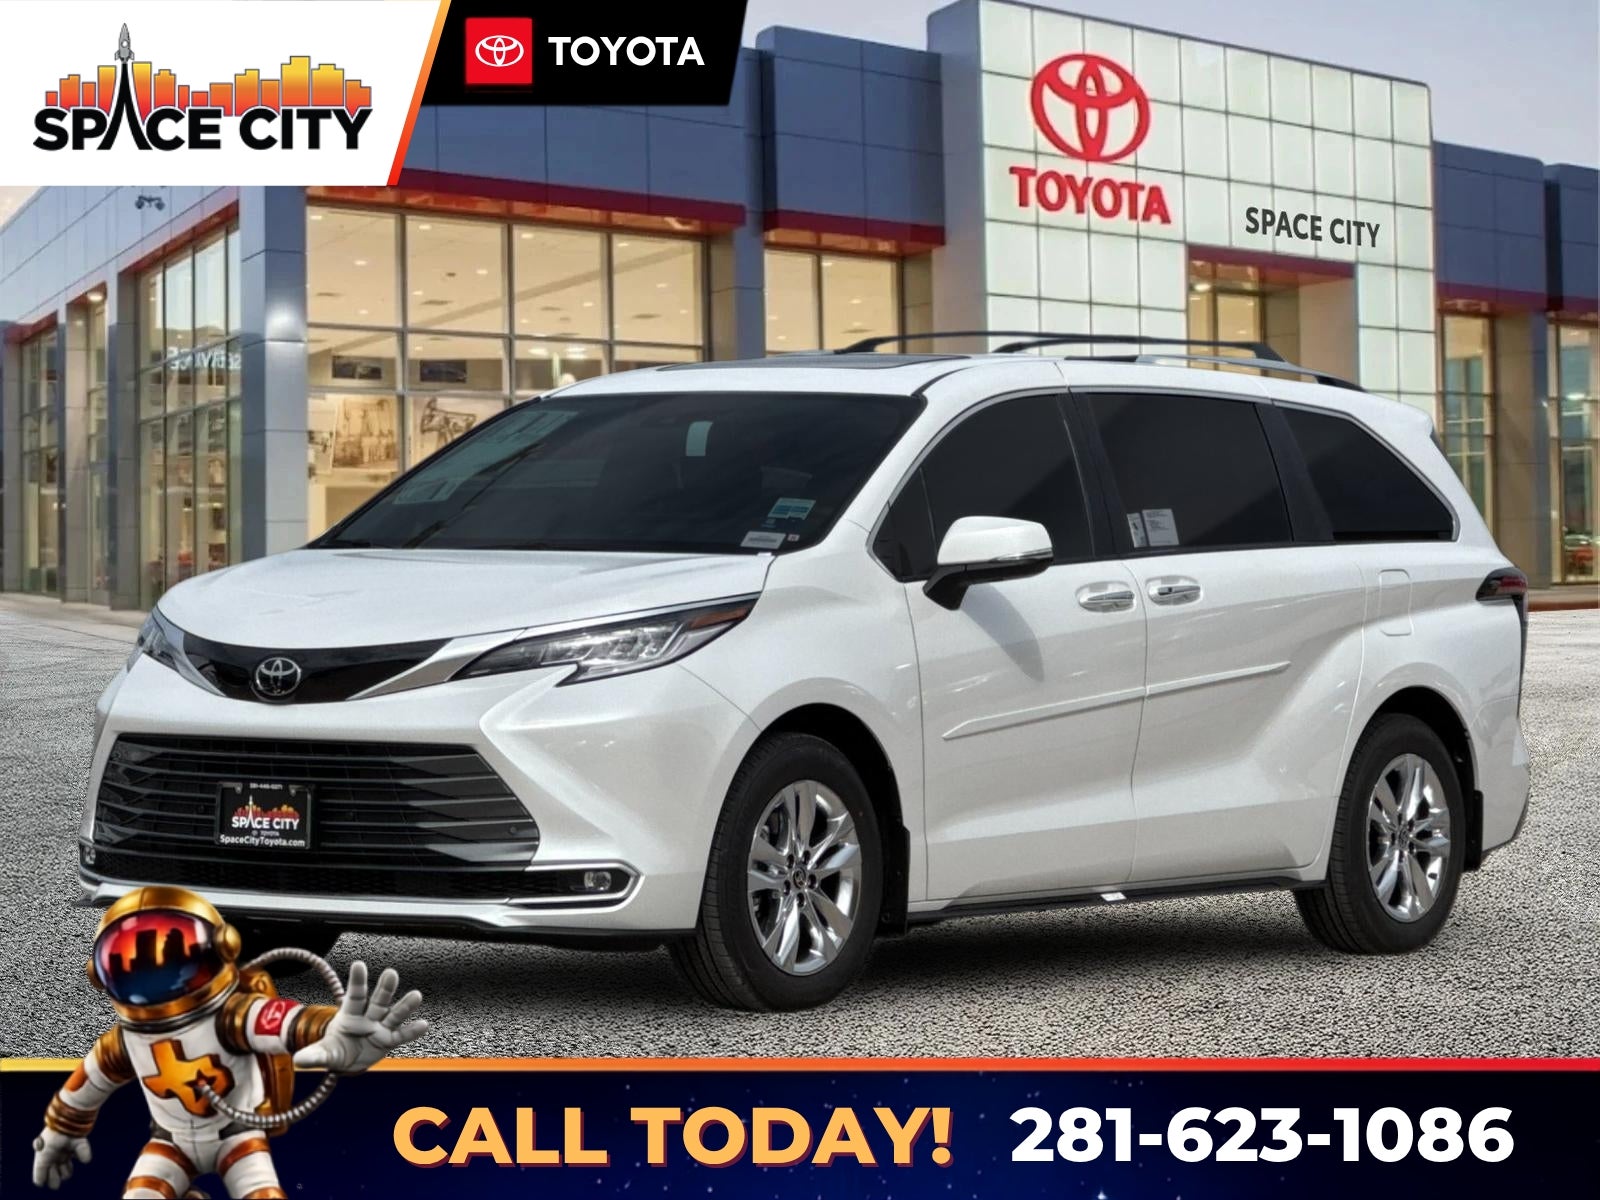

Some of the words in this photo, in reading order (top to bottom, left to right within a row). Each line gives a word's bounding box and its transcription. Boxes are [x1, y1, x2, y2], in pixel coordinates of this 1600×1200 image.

[1010, 166, 1170, 223] TOYOTA
[1245, 206, 1323, 241] SPACE
[1330, 218, 1381, 248] CITY
[231, 815, 270, 829] SPACE
[273, 817, 300, 830] CITY
[220, 834, 306, 847] SpaceCityToyota.com
